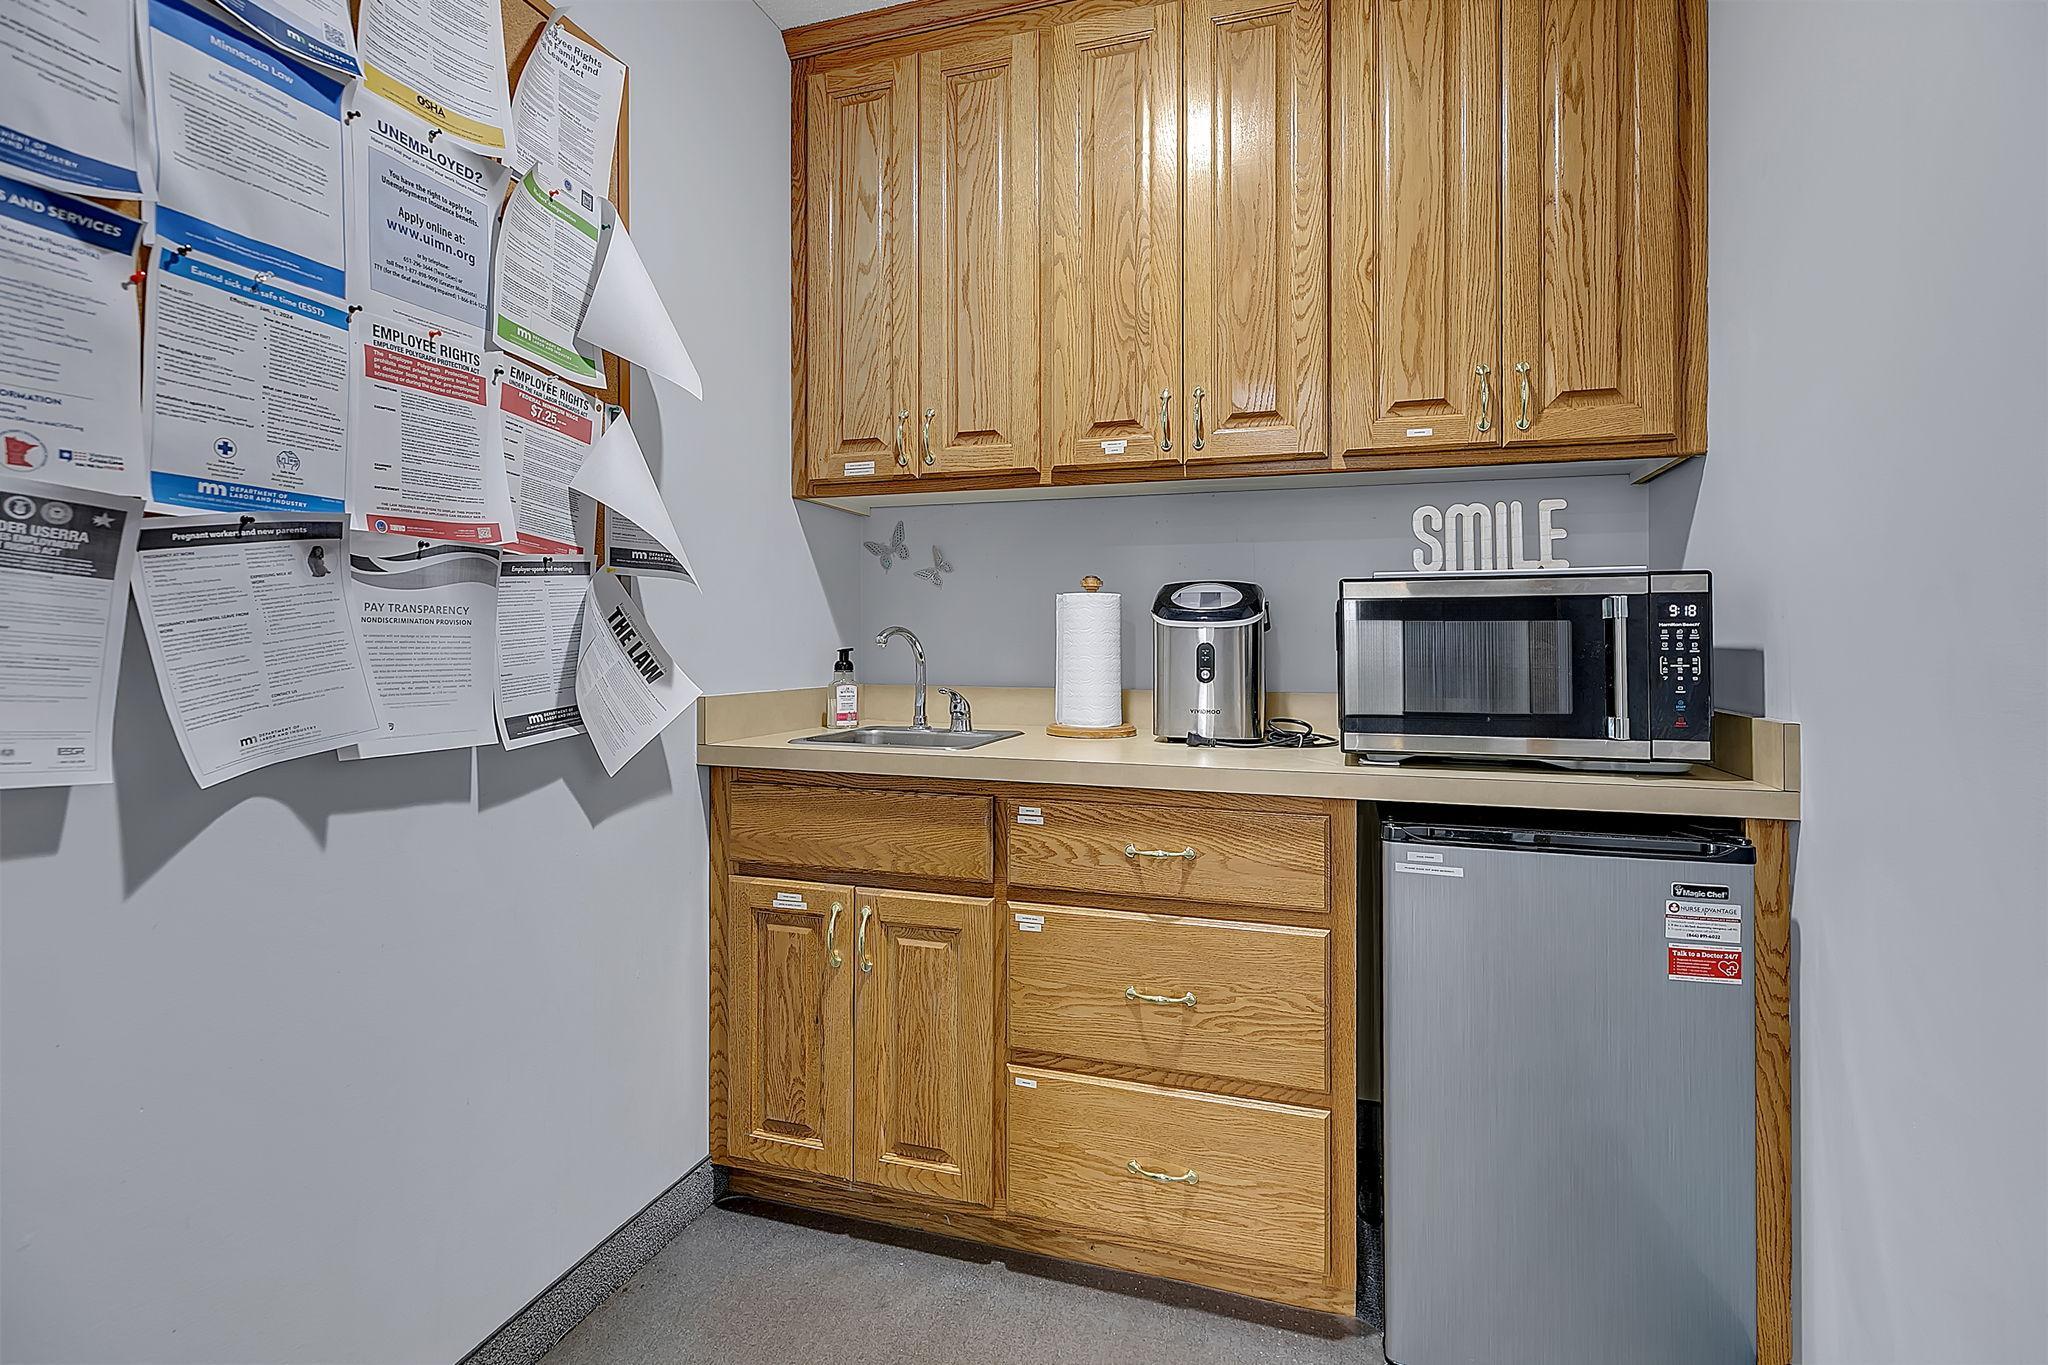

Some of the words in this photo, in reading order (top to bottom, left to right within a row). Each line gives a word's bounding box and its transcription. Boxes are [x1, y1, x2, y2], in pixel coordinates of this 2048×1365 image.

[210, 34, 269, 72] Minnesota
[272, 66, 294, 84] Law
[548, 46, 568, 68] Leave
[570, 65, 584, 78] Act
[554, 42, 580, 66] Family
[582, 64, 598, 76] and
[574, 46, 602, 68] Rights
[417, 95, 446, 118] OSHA
[24, 145, 79, 168] INDUSTRY
[378, 120, 483, 183] UNEMPLOYED?
[382, 176, 428, 203] Unemployment
[428, 196, 454, 216] Insurance
[389, 169, 400, 181] You
[401, 175, 415, 188] have
[416, 182, 426, 193] the
[427, 188, 441, 200] right
[448, 199, 464, 212] apply
[464, 206, 472, 215] for
[8, 194, 45, 212] AND
[48, 206, 122, 237] SERVICES
[398, 206, 424, 228] Apply
[426, 220, 452, 240] online
[454, 231, 466, 245] at:
[386, 219, 475, 266] www.uimn.org
[191, 266, 223, 284] Earned
[224, 278, 241, 290] sick
[260, 290, 278, 301] safe
[280, 295, 297, 308] time
[298, 300, 325, 317] (ESST)
[372, 324, 436, 354] EMPLOYEE
[440, 345, 480, 366] RIGHTS
[373, 340, 404, 353] EMPLOYEE
[405, 348, 436, 363] POLYGRAPH
[437, 356, 469, 371] PROTECTION
[470, 366, 479, 374] ACT
[406, 378, 421, 387] during
[510, 366, 557, 396] EMPLOYEE
[560, 389, 589, 411] RIGHTS
[533, 389, 542, 397] FAIR
[543, 394, 557, 404] LABOR
[530, 404, 557, 424] $7.25
[230, 486, 276, 498] DEPARTMENT
[230, 492, 254, 500] LABOR
[273, 498, 307, 508] INDUSTRY
[30, 525, 89, 543] USERRA
[172, 532, 209, 541] Pregnant
[276, 528, 307, 536] parents
[1412, 499, 1570, 571] SMILE
[364, 603, 384, 611] PAY
[388, 604, 469, 615] TRANSPARENCY
[1669, 604, 1696, 617] 9:18
[608, 606, 636, 647] THE
[626, 640, 664, 685] LAW
[544, 709, 568, 717] DEPARTMENT
[259, 727, 291, 737] DEPARTMENT
[290, 726, 316, 734] INDUSTRY
[1683, 890, 1705, 898] Magic
